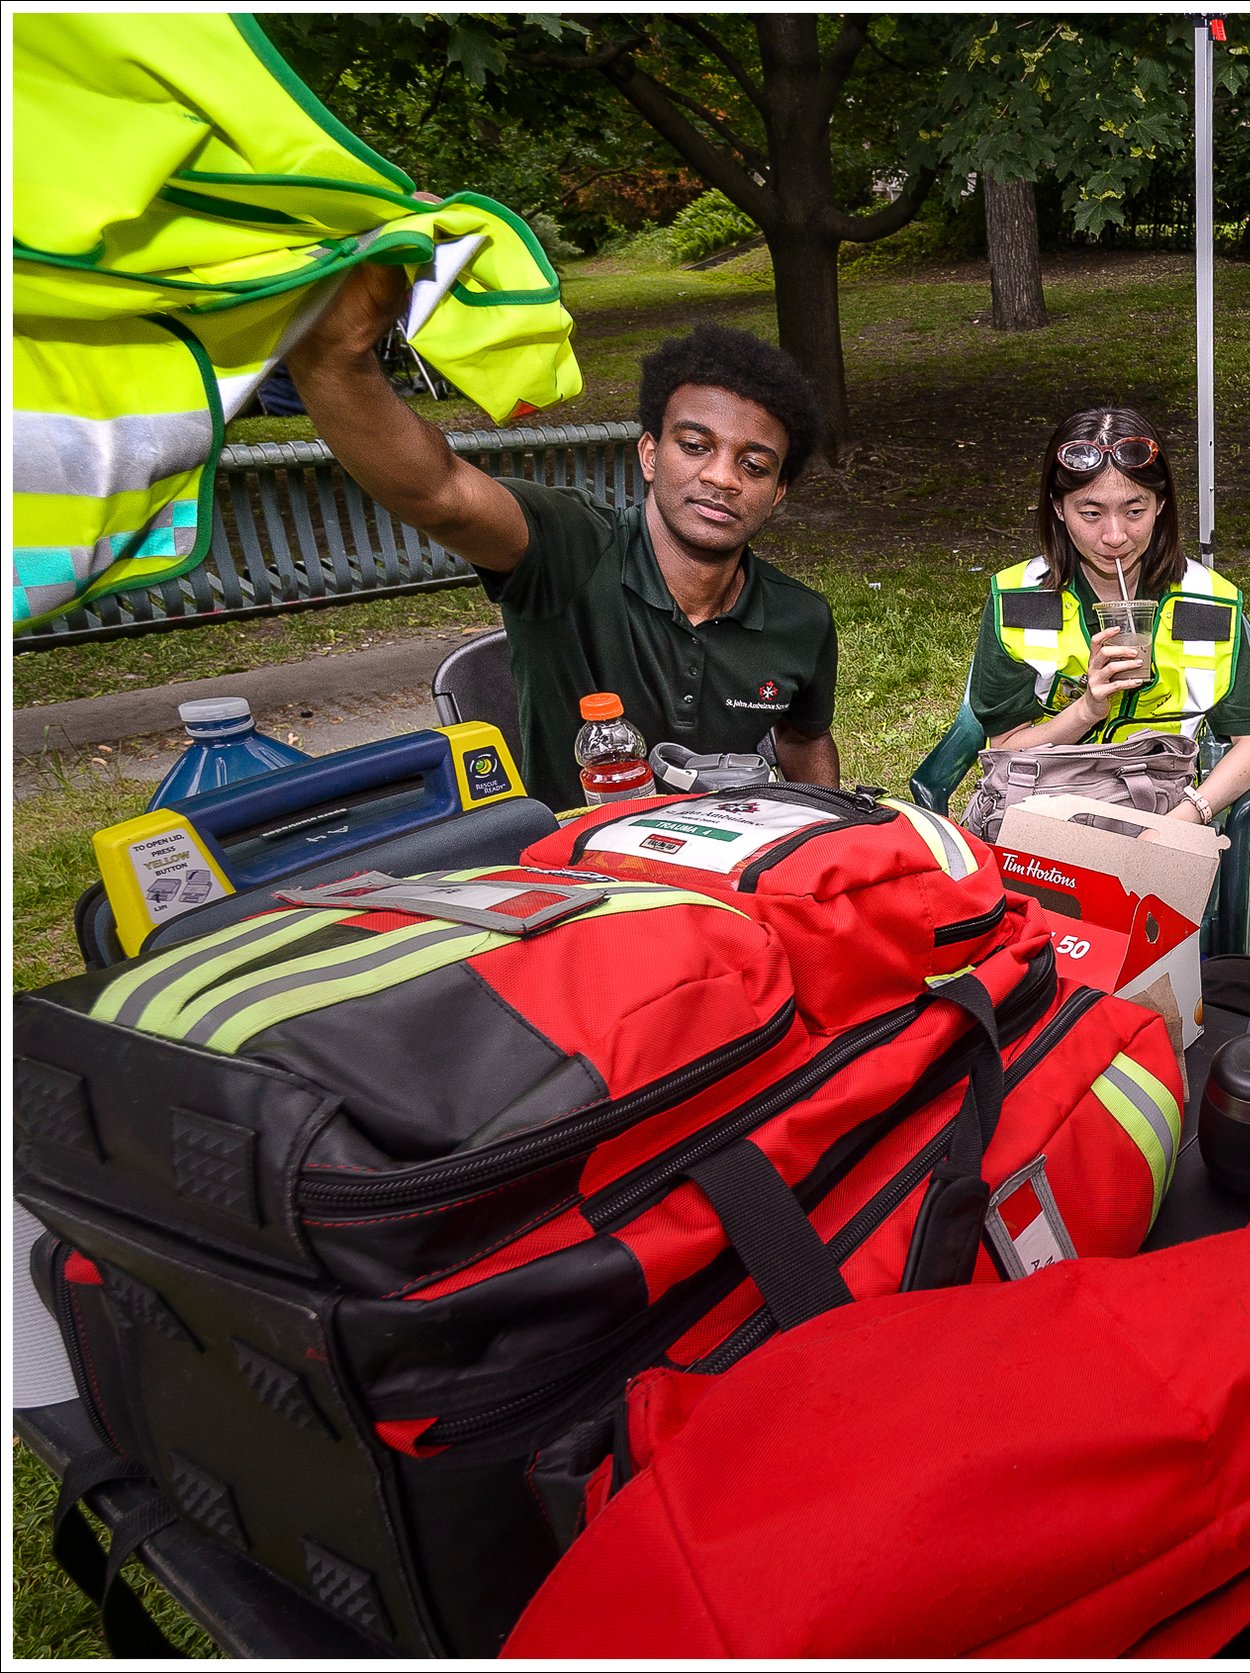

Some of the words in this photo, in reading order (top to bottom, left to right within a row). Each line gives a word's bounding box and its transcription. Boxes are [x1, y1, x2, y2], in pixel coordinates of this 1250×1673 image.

[655, 821, 698, 834] TRAUMA
[132, 844, 146, 852] TO
[146, 837, 169, 849] OPEN
[151, 845, 177, 857] PRESS
[143, 850, 191, 870] YELLOW
[155, 862, 188, 876] BUTTON
[1002, 852, 1026, 876] Tim
[1026, 858, 1077, 889] Hortons
[1055, 934, 1091, 960] 50
